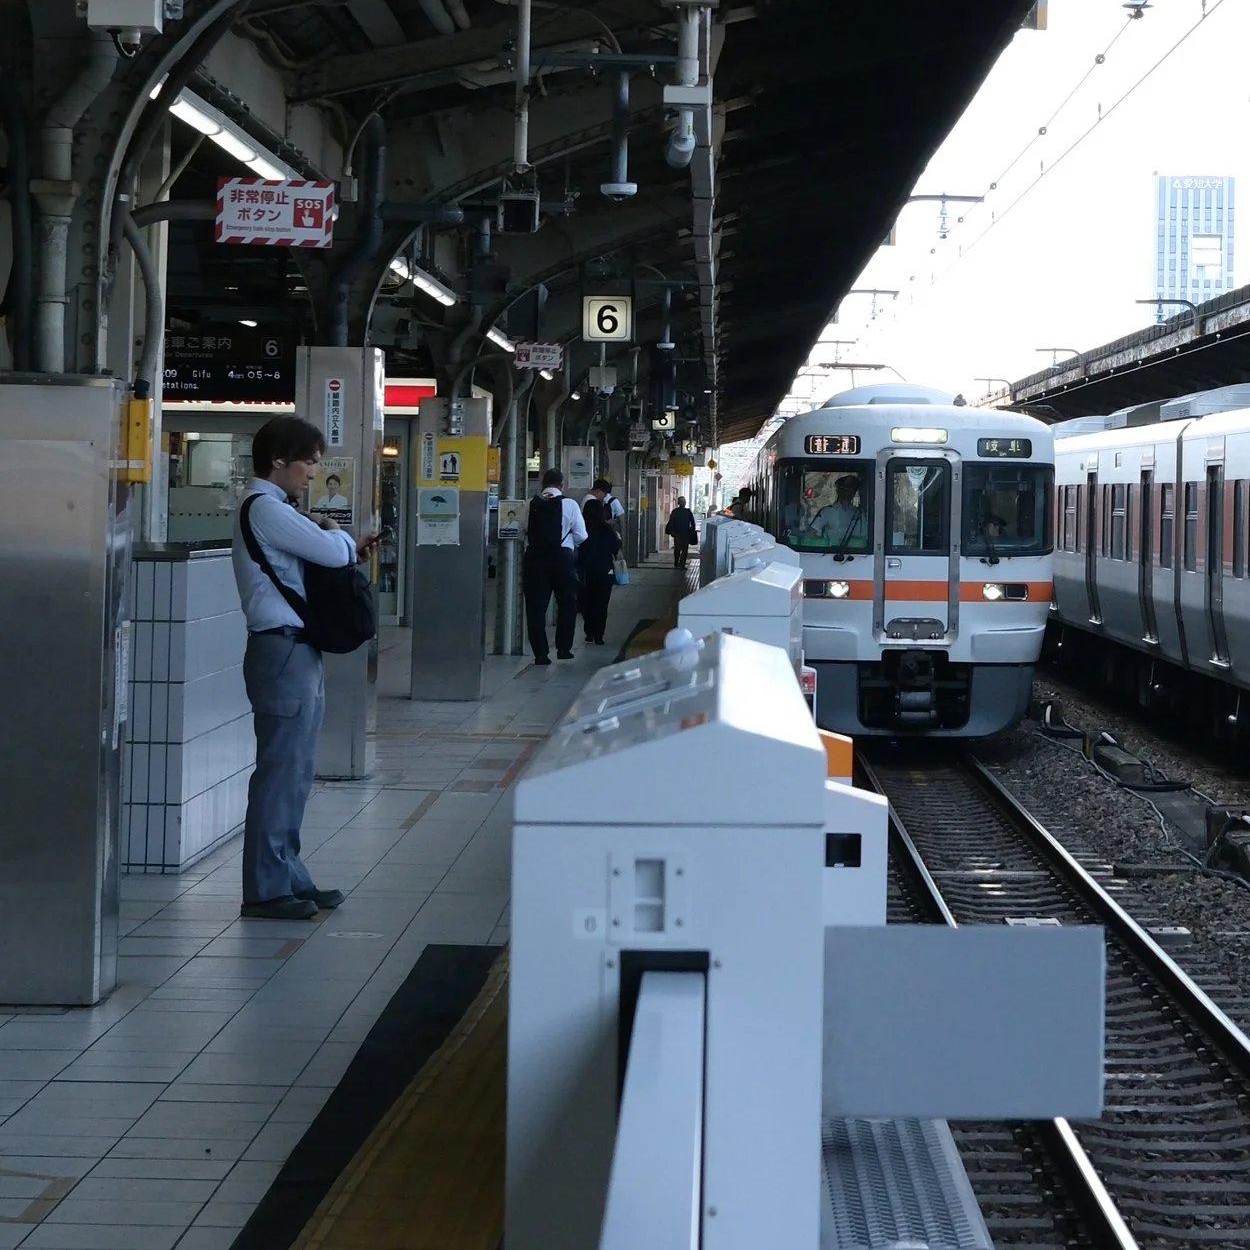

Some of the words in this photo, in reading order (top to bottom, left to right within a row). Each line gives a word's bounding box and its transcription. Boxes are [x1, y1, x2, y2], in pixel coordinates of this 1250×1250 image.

[230, 190, 290, 205] 非常停止
[296, 199, 321, 210] SOS
[237, 208, 281, 222] ボタン
[597, 305, 618, 334] 6
[264, 339, 279, 357] 6
[192, 369, 211, 379] Gifu
